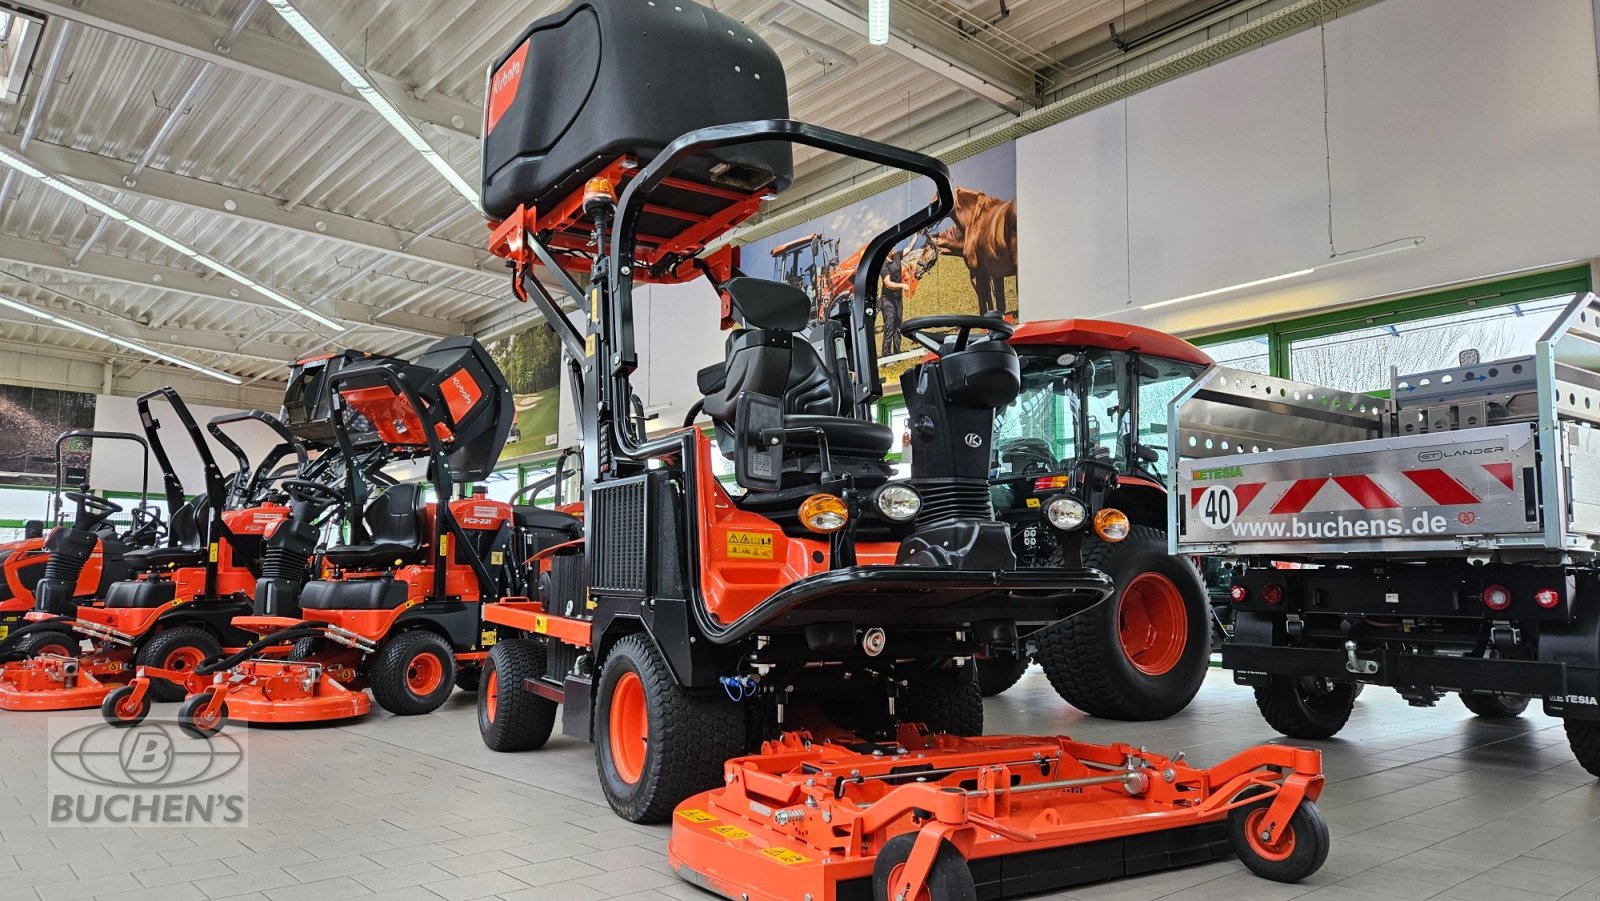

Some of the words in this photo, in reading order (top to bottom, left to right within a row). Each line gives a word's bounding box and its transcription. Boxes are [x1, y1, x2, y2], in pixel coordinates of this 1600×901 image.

[493, 61, 521, 93] Kubota
[452, 376, 472, 405] Kubota
[1200, 465, 1244, 480] ETESIA
[1205, 489, 1231, 525] 40
[1231, 511, 1448, 538] www.buchens.de
